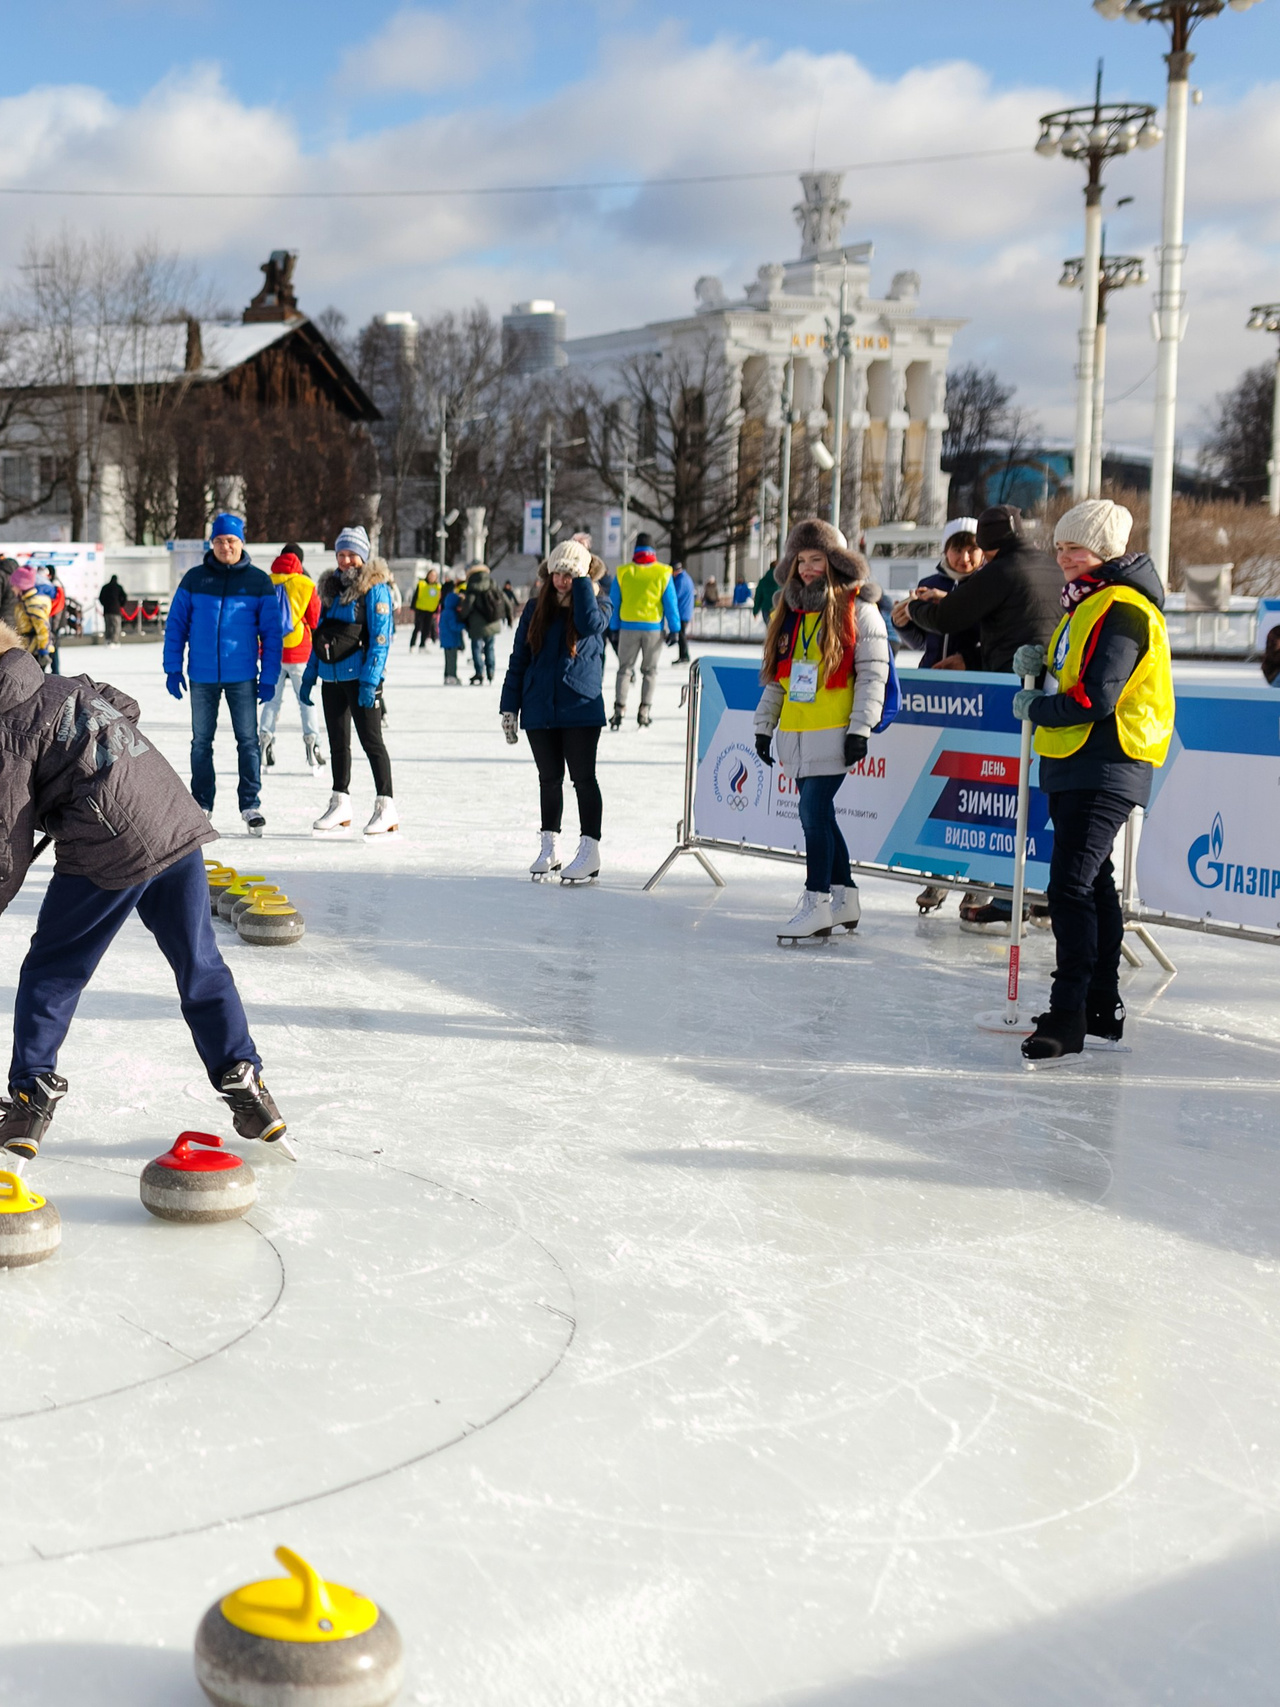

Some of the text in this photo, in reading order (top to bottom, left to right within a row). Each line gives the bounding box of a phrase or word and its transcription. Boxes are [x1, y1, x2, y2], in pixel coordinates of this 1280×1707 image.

[899, 693, 984, 718] наших!
[736, 743, 762, 769] КОМИТЕТ
[980, 759, 1006, 777] ДЕНЬ
[847, 808, 878, 820] РАЗВИТИЮ
[957, 788, 1020, 820] ЗИМНИ
[944, 826, 1037, 857] ВИДОВ СПОА
